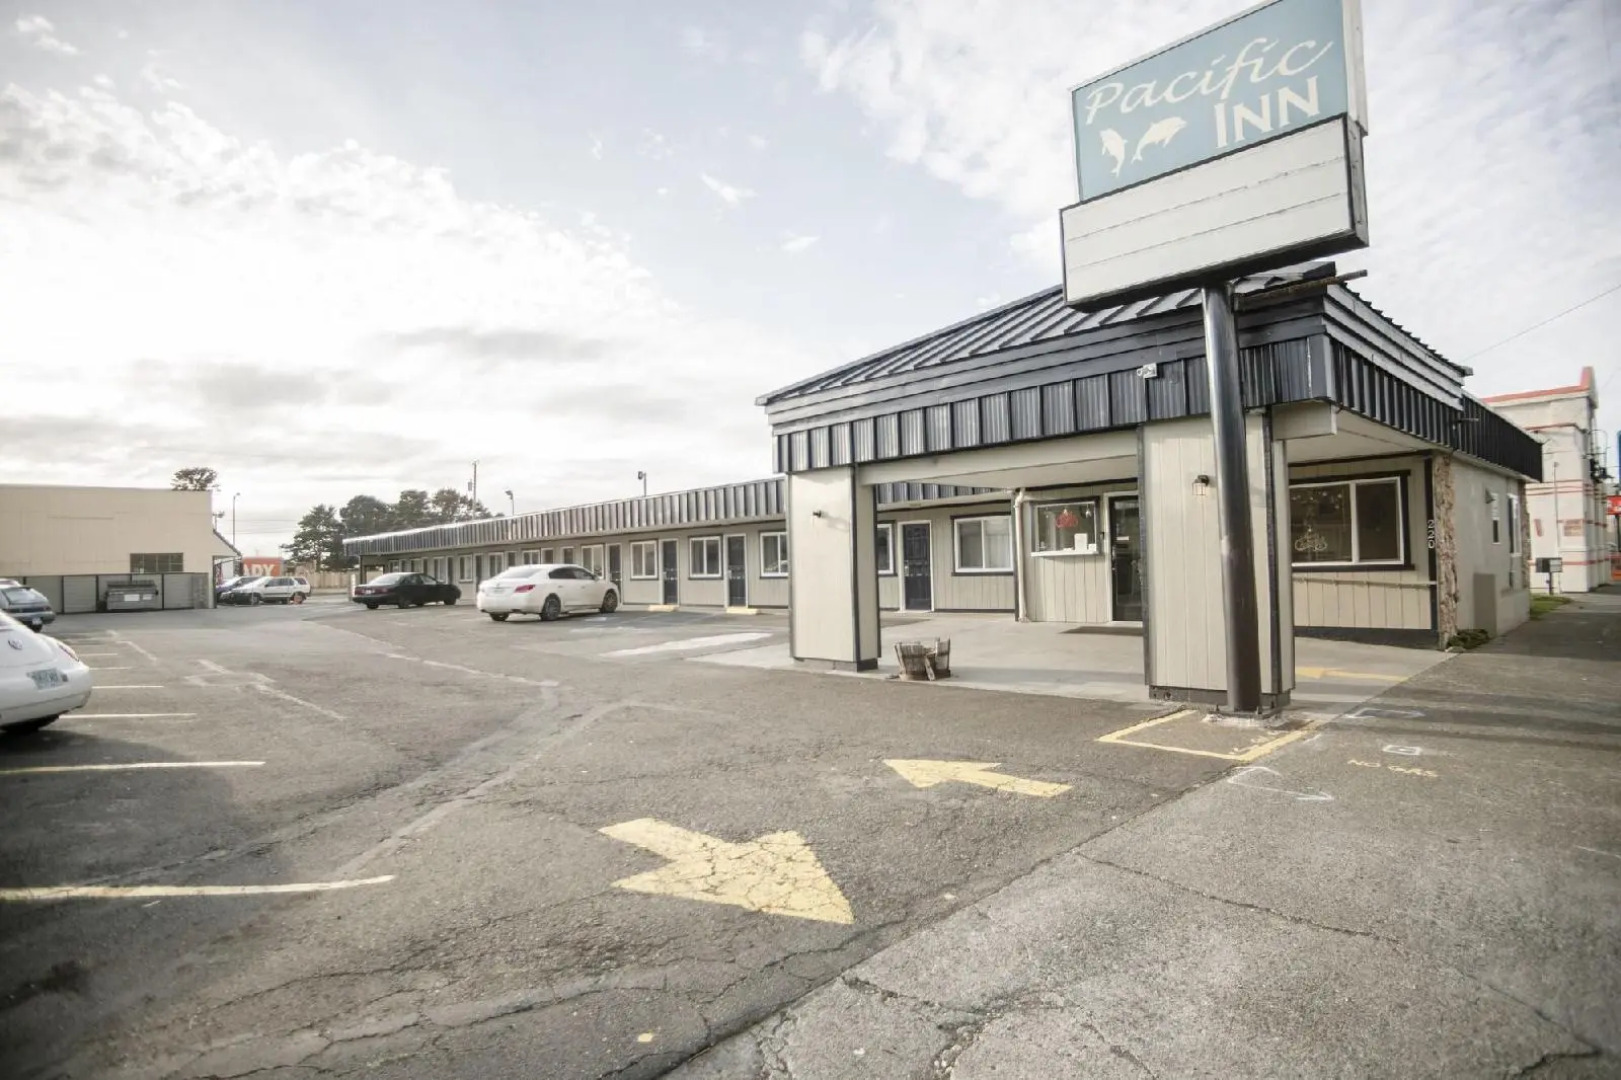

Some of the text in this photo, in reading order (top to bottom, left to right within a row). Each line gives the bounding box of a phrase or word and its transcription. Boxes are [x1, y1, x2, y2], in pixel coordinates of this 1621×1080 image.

[1085, 37, 1334, 125] Pacific
[1213, 75, 1321, 149] INN
[1427, 519, 1435, 549] 220
